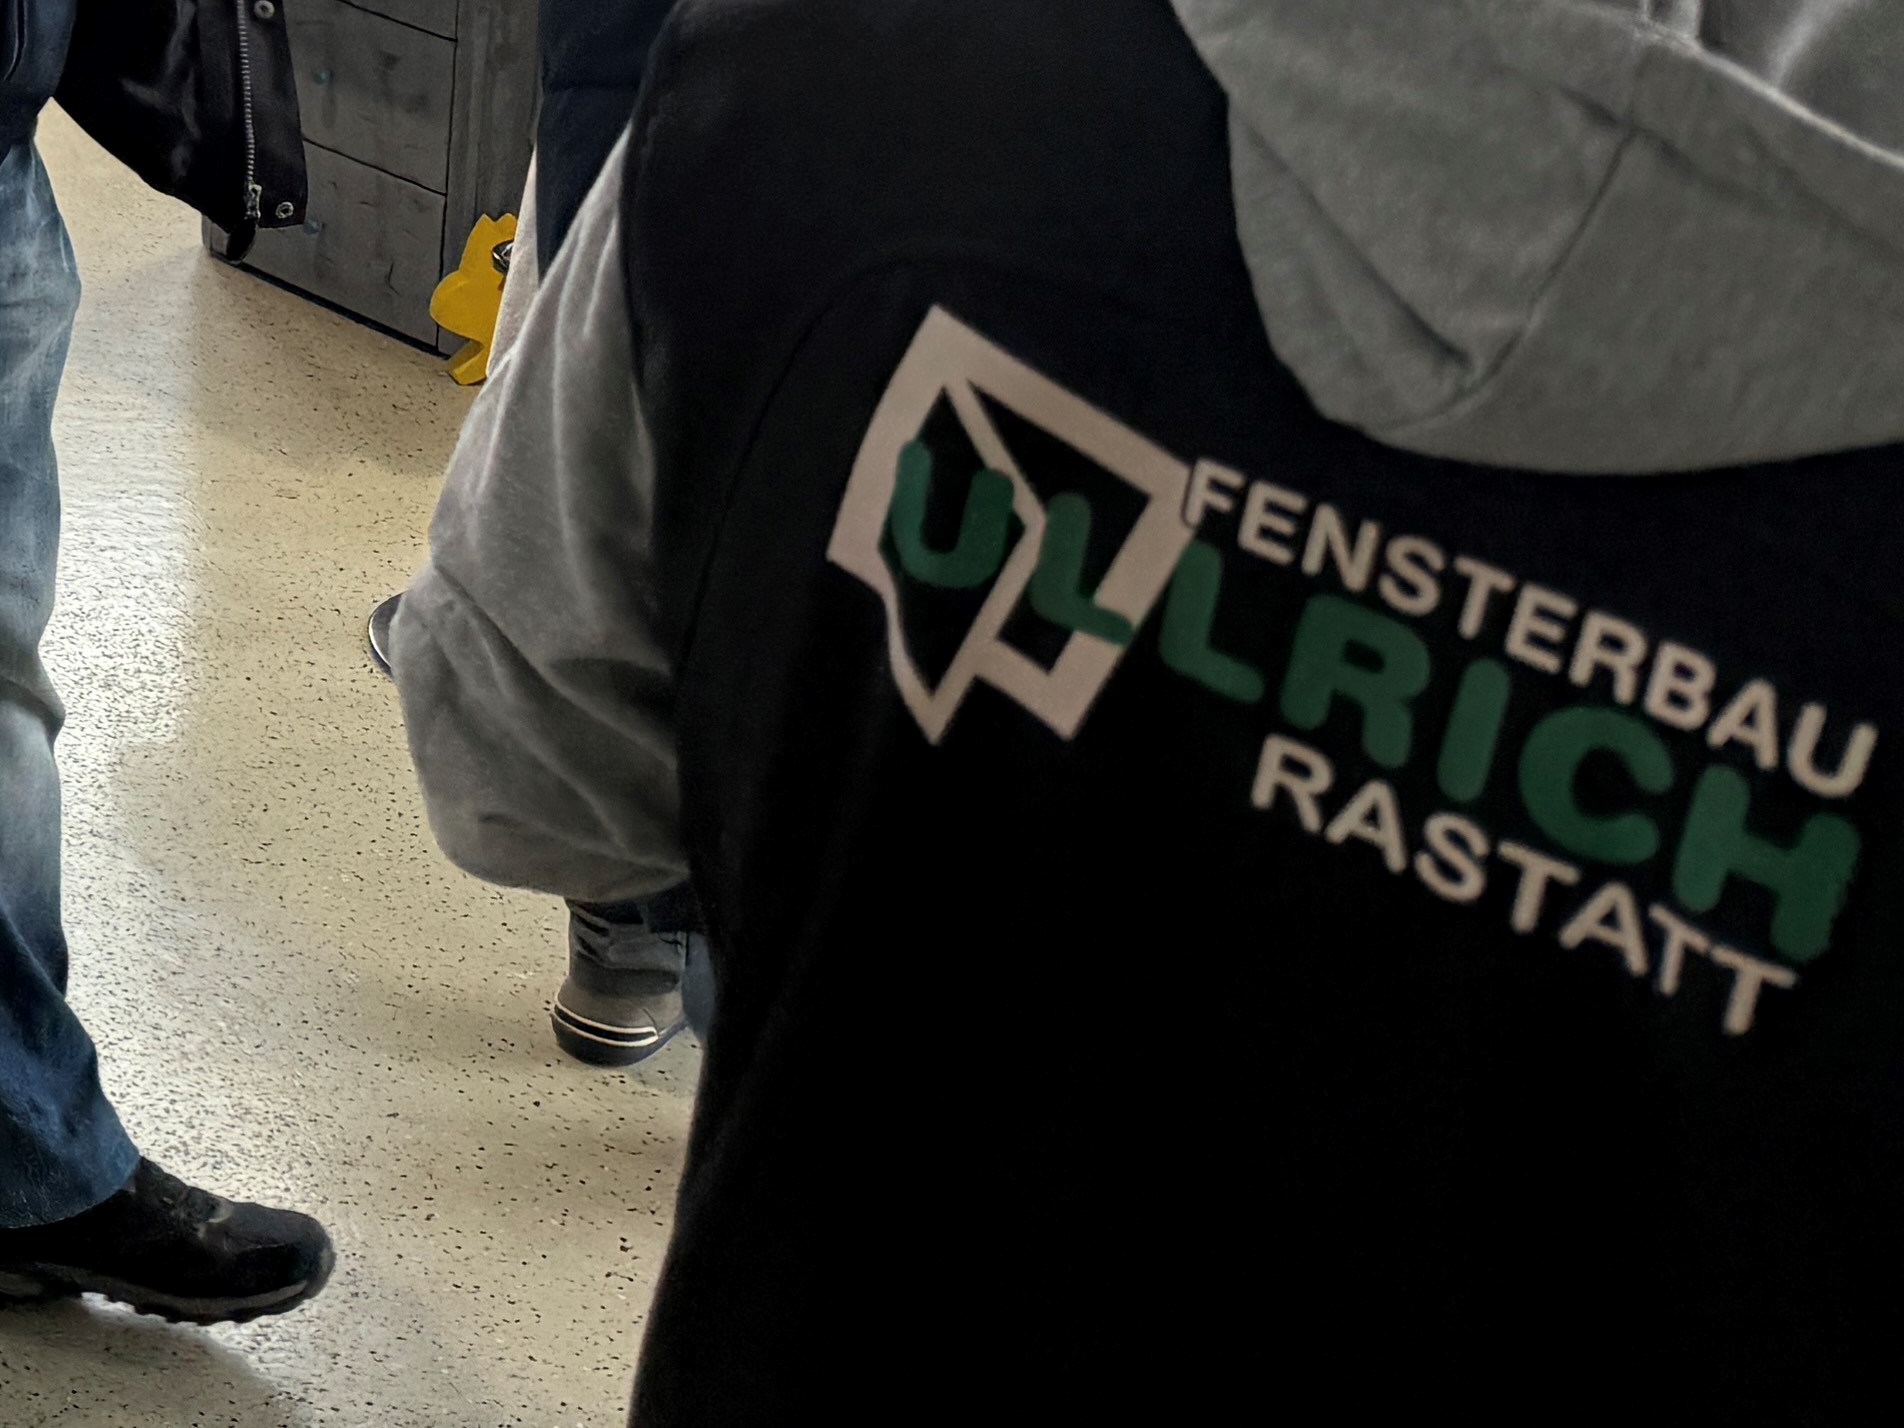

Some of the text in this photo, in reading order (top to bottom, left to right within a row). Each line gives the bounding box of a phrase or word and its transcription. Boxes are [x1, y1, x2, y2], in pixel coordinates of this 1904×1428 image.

[889, 439, 1861, 961] ULLRICH
[1186, 457, 1878, 797] FENSTERBAU
[1249, 733, 1798, 1035] RASTATT
